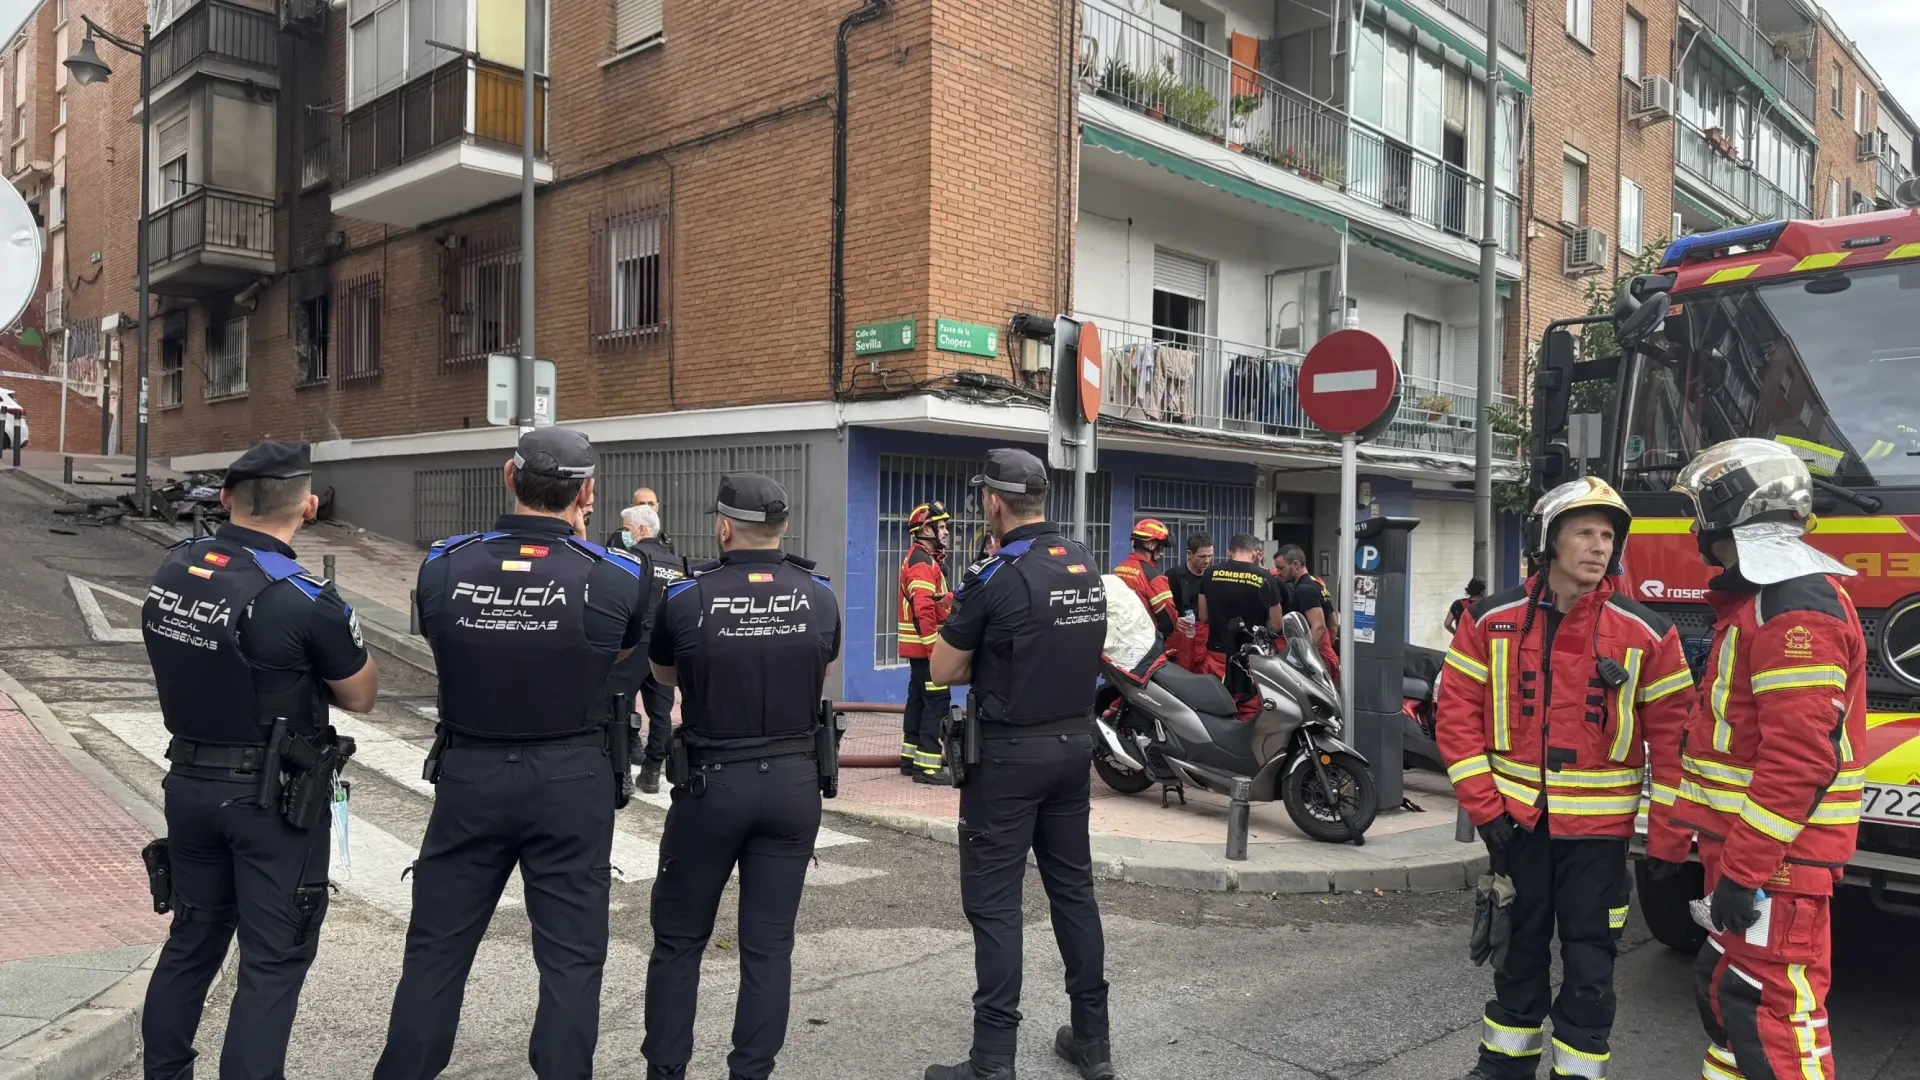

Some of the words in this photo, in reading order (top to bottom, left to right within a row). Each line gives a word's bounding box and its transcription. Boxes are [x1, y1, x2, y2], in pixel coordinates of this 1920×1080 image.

[855, 330, 869, 338] Calle
[870, 328, 876, 336] de
[940, 324, 956, 334] Paseo
[957, 327, 964, 335] de
[855, 339, 882, 351] Sevilla
[939, 334, 972, 349] Chopera
[1361, 545, 1378, 569] P
[1212, 569, 1263, 584] BOMBEROS
[452, 579, 566, 606] POLICÍA
[148, 585, 231, 627] POLICÍA
[710, 587, 810, 614] POLICÍA
[480, 608, 533, 617] LOCAL
[1069, 605, 1097, 613] LOCAL
[162, 615, 200, 632] LOCAL
[455, 616, 559, 631] ALCOBENDAS
[739, 616, 785, 624] LOCAL
[1053, 612, 1105, 626] ALCOBENDAS
[146, 620, 218, 650] ALCOBENDAS
[717, 623, 807, 636] ALCOBENDAS
[1863, 786, 1920, 818] 722
